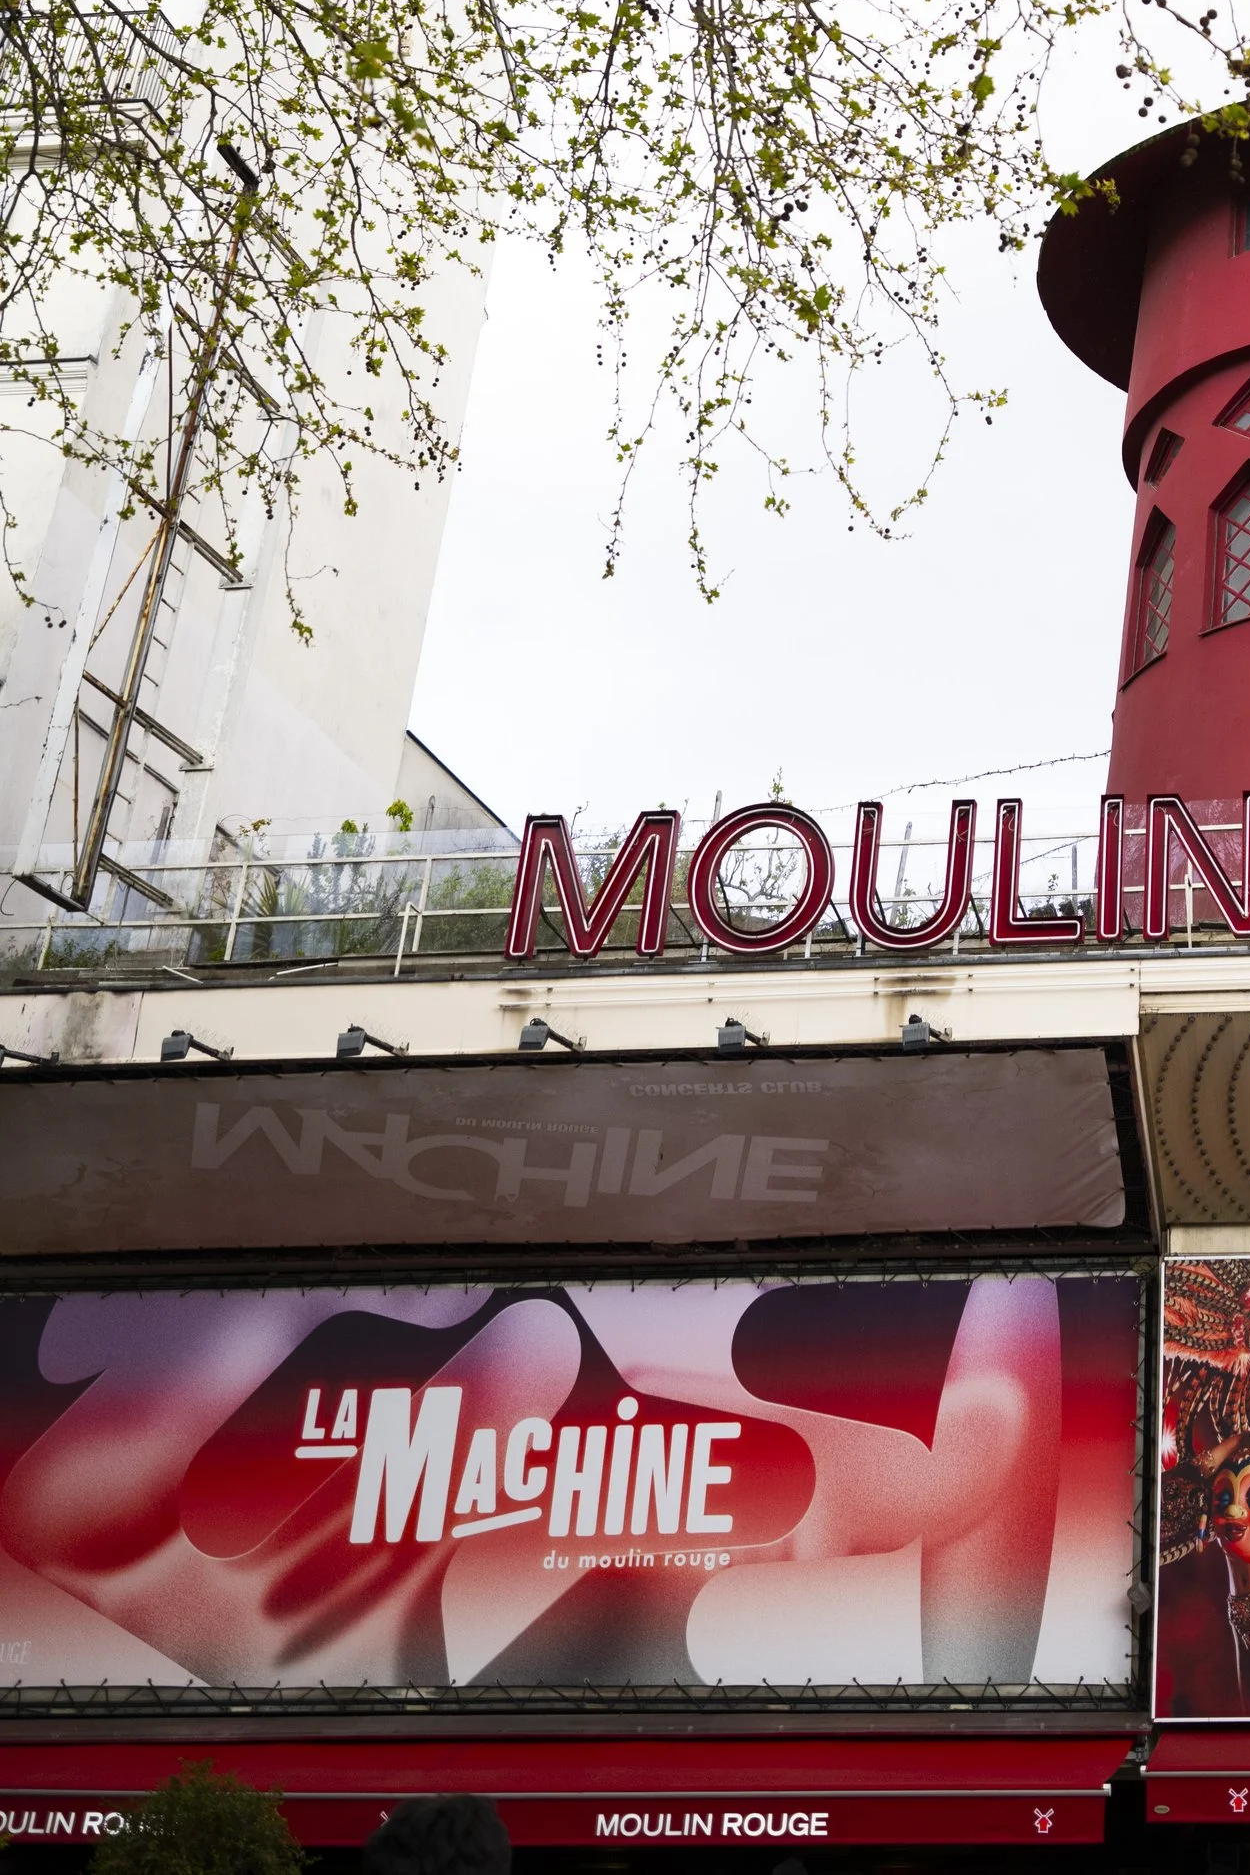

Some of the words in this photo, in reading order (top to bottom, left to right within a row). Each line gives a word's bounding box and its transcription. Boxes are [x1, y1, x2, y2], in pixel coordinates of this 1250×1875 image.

[302, 1388, 358, 1440] LA
[543, 1550, 569, 1569] du
[578, 1549, 656, 1568] moulin
[664, 1550, 731, 1571] rouge
[595, 1812, 713, 1837] MOULIN
[721, 1811, 829, 1836] ROUGE
